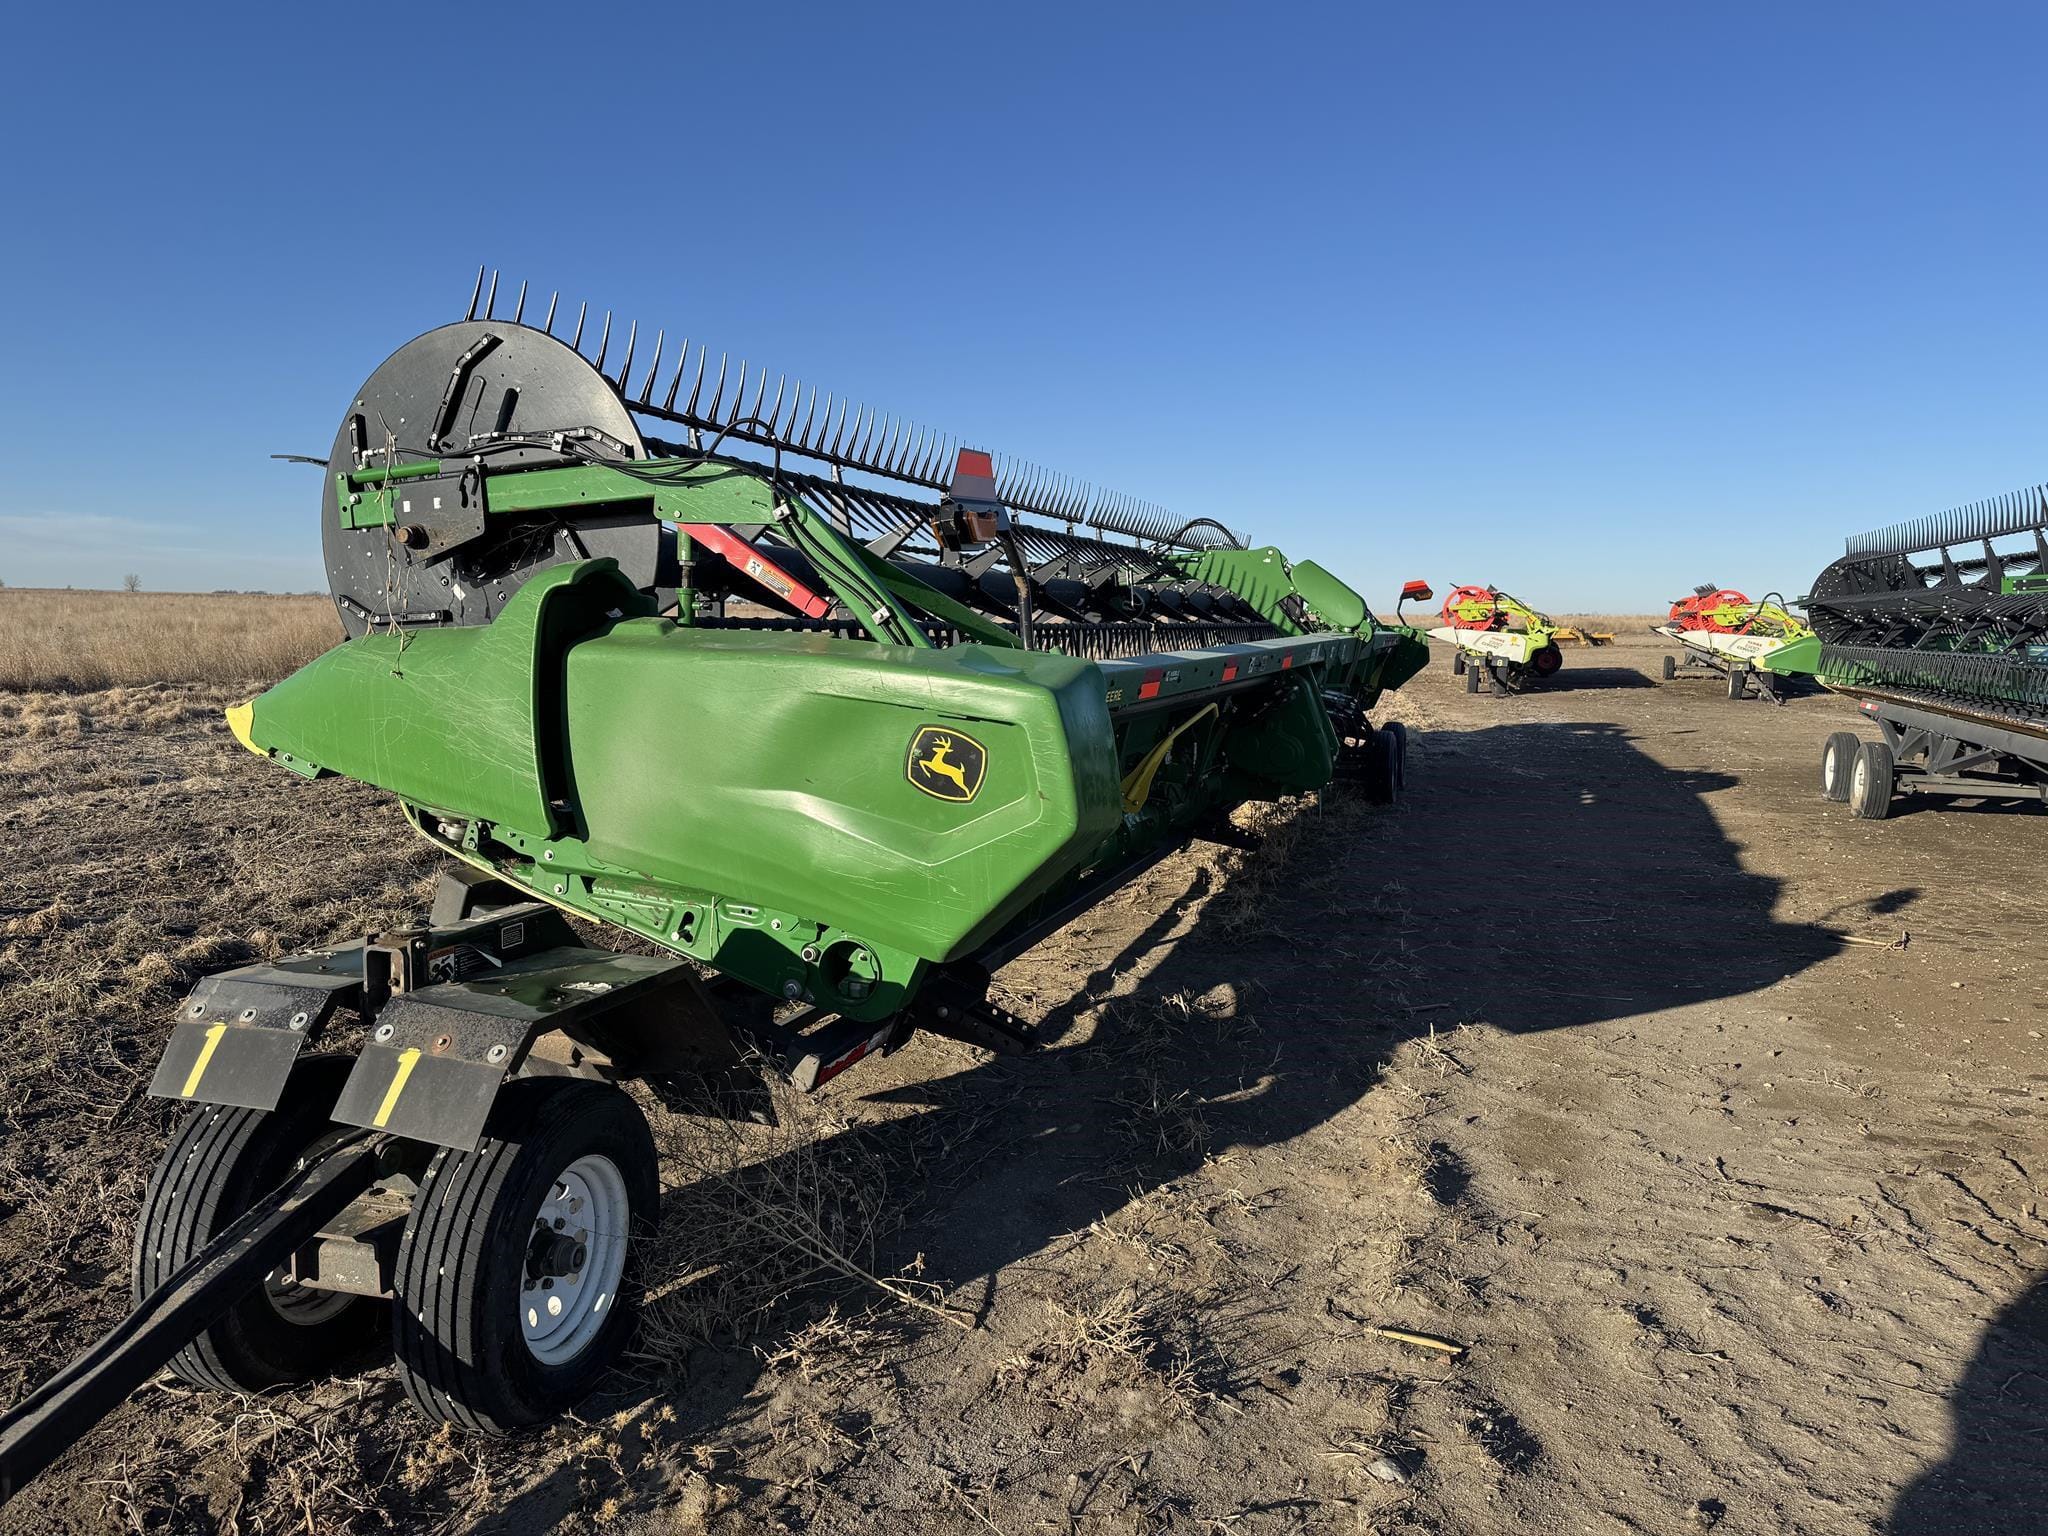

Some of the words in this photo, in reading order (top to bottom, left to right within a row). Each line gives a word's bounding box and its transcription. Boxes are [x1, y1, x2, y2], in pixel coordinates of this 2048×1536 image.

[1105, 689, 1123, 703] EERE
[181, 1022, 228, 1097] 1
[372, 1048, 422, 1127] 1
